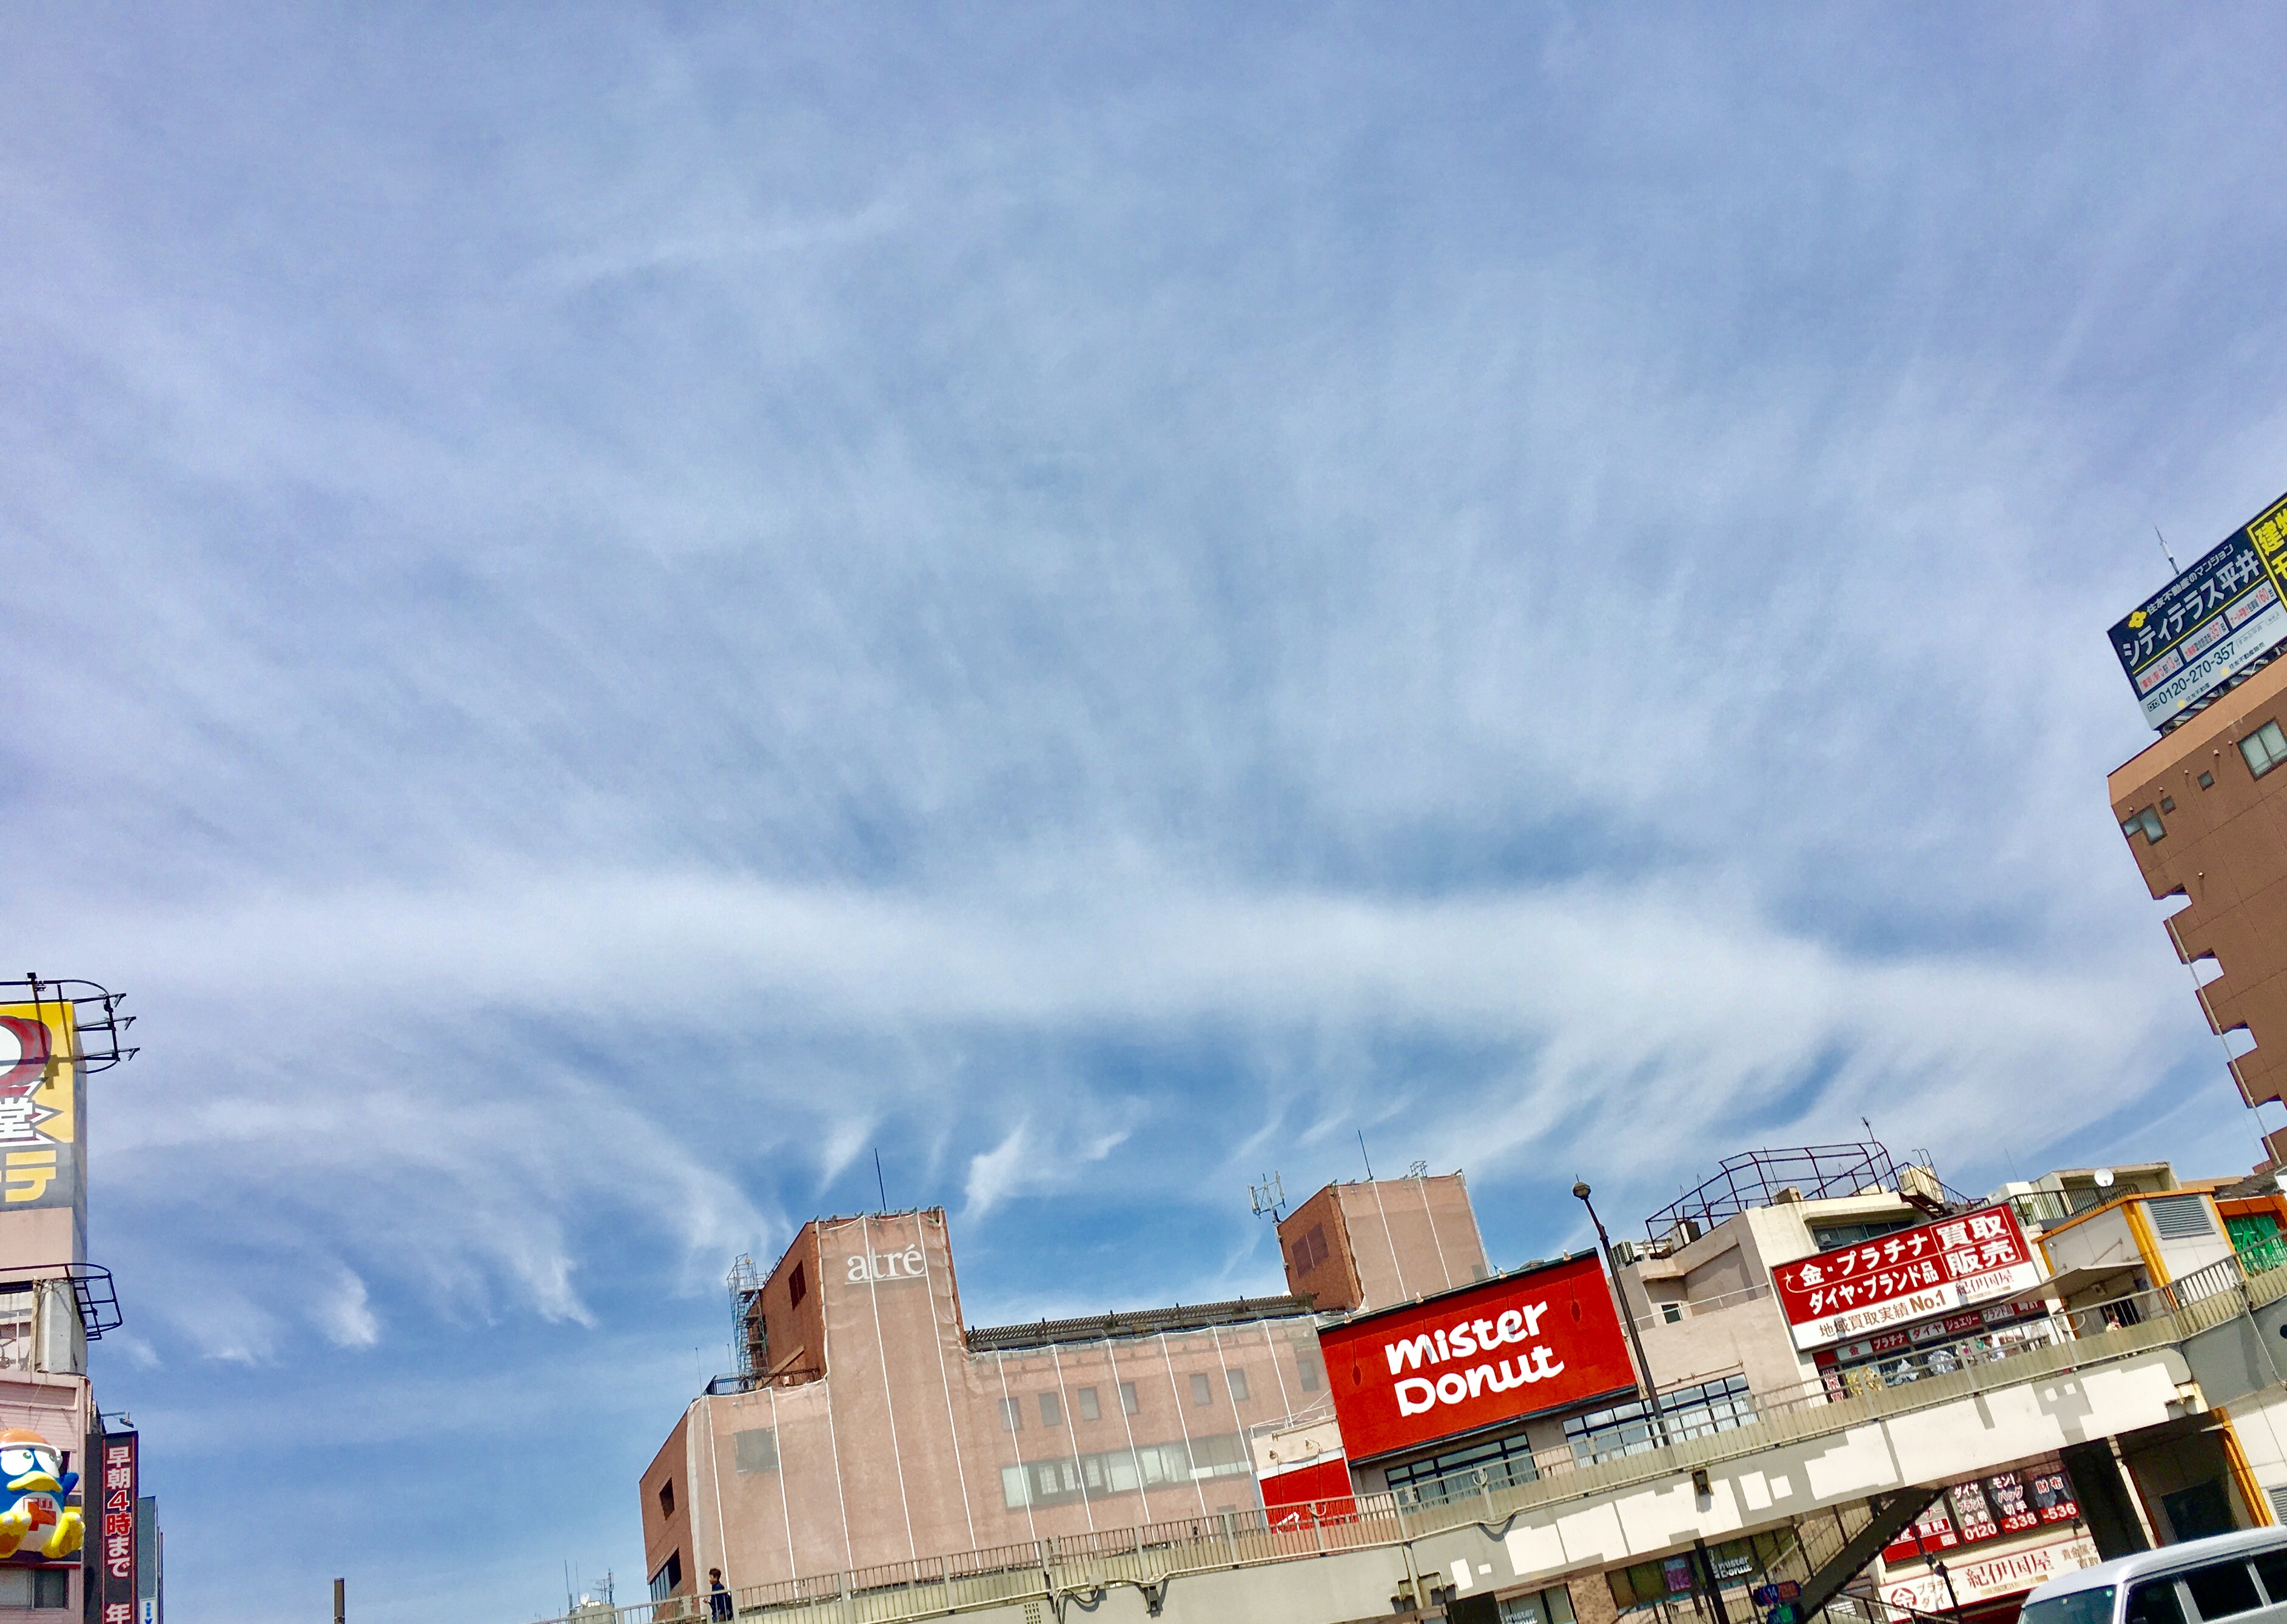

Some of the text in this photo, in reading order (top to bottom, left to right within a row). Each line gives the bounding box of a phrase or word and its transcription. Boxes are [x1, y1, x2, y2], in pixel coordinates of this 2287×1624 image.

[2146, 543, 2234, 615] 住友不動産のマンション
[2123, 548, 2260, 667] シティテラス平井
[2158, 642, 2236, 705] 0120-270-357
[1938, 1215, 2007, 1251] 買取
[847, 1243, 924, 1282] atré
[1799, 1232, 1929, 1287] 金・プラチナ
[1945, 1238, 2016, 1277] 販売
[1808, 1260, 1941, 1315] ダイヤ・ブランド品
[1909, 1289, 1947, 1314] No.1
[1873, 1332, 1906, 1351] プラチナ
[1912, 1321, 1943, 1340] ダイヤ
[1394, 1345, 1565, 1417] Donut
[1953, 1482, 1979, 1500] ダイヤ
[2035, 1476, 2064, 1495] 財布
[106, 1446, 131, 1579] 早朝4時まで
[1919, 1519, 1946, 1536] 無料
[1963, 1499, 2028, 1527] 金券 切手
[1964, 1523, 1997, 1541] 0120
[1964, 1550, 2055, 1590] 紀伊国屋
